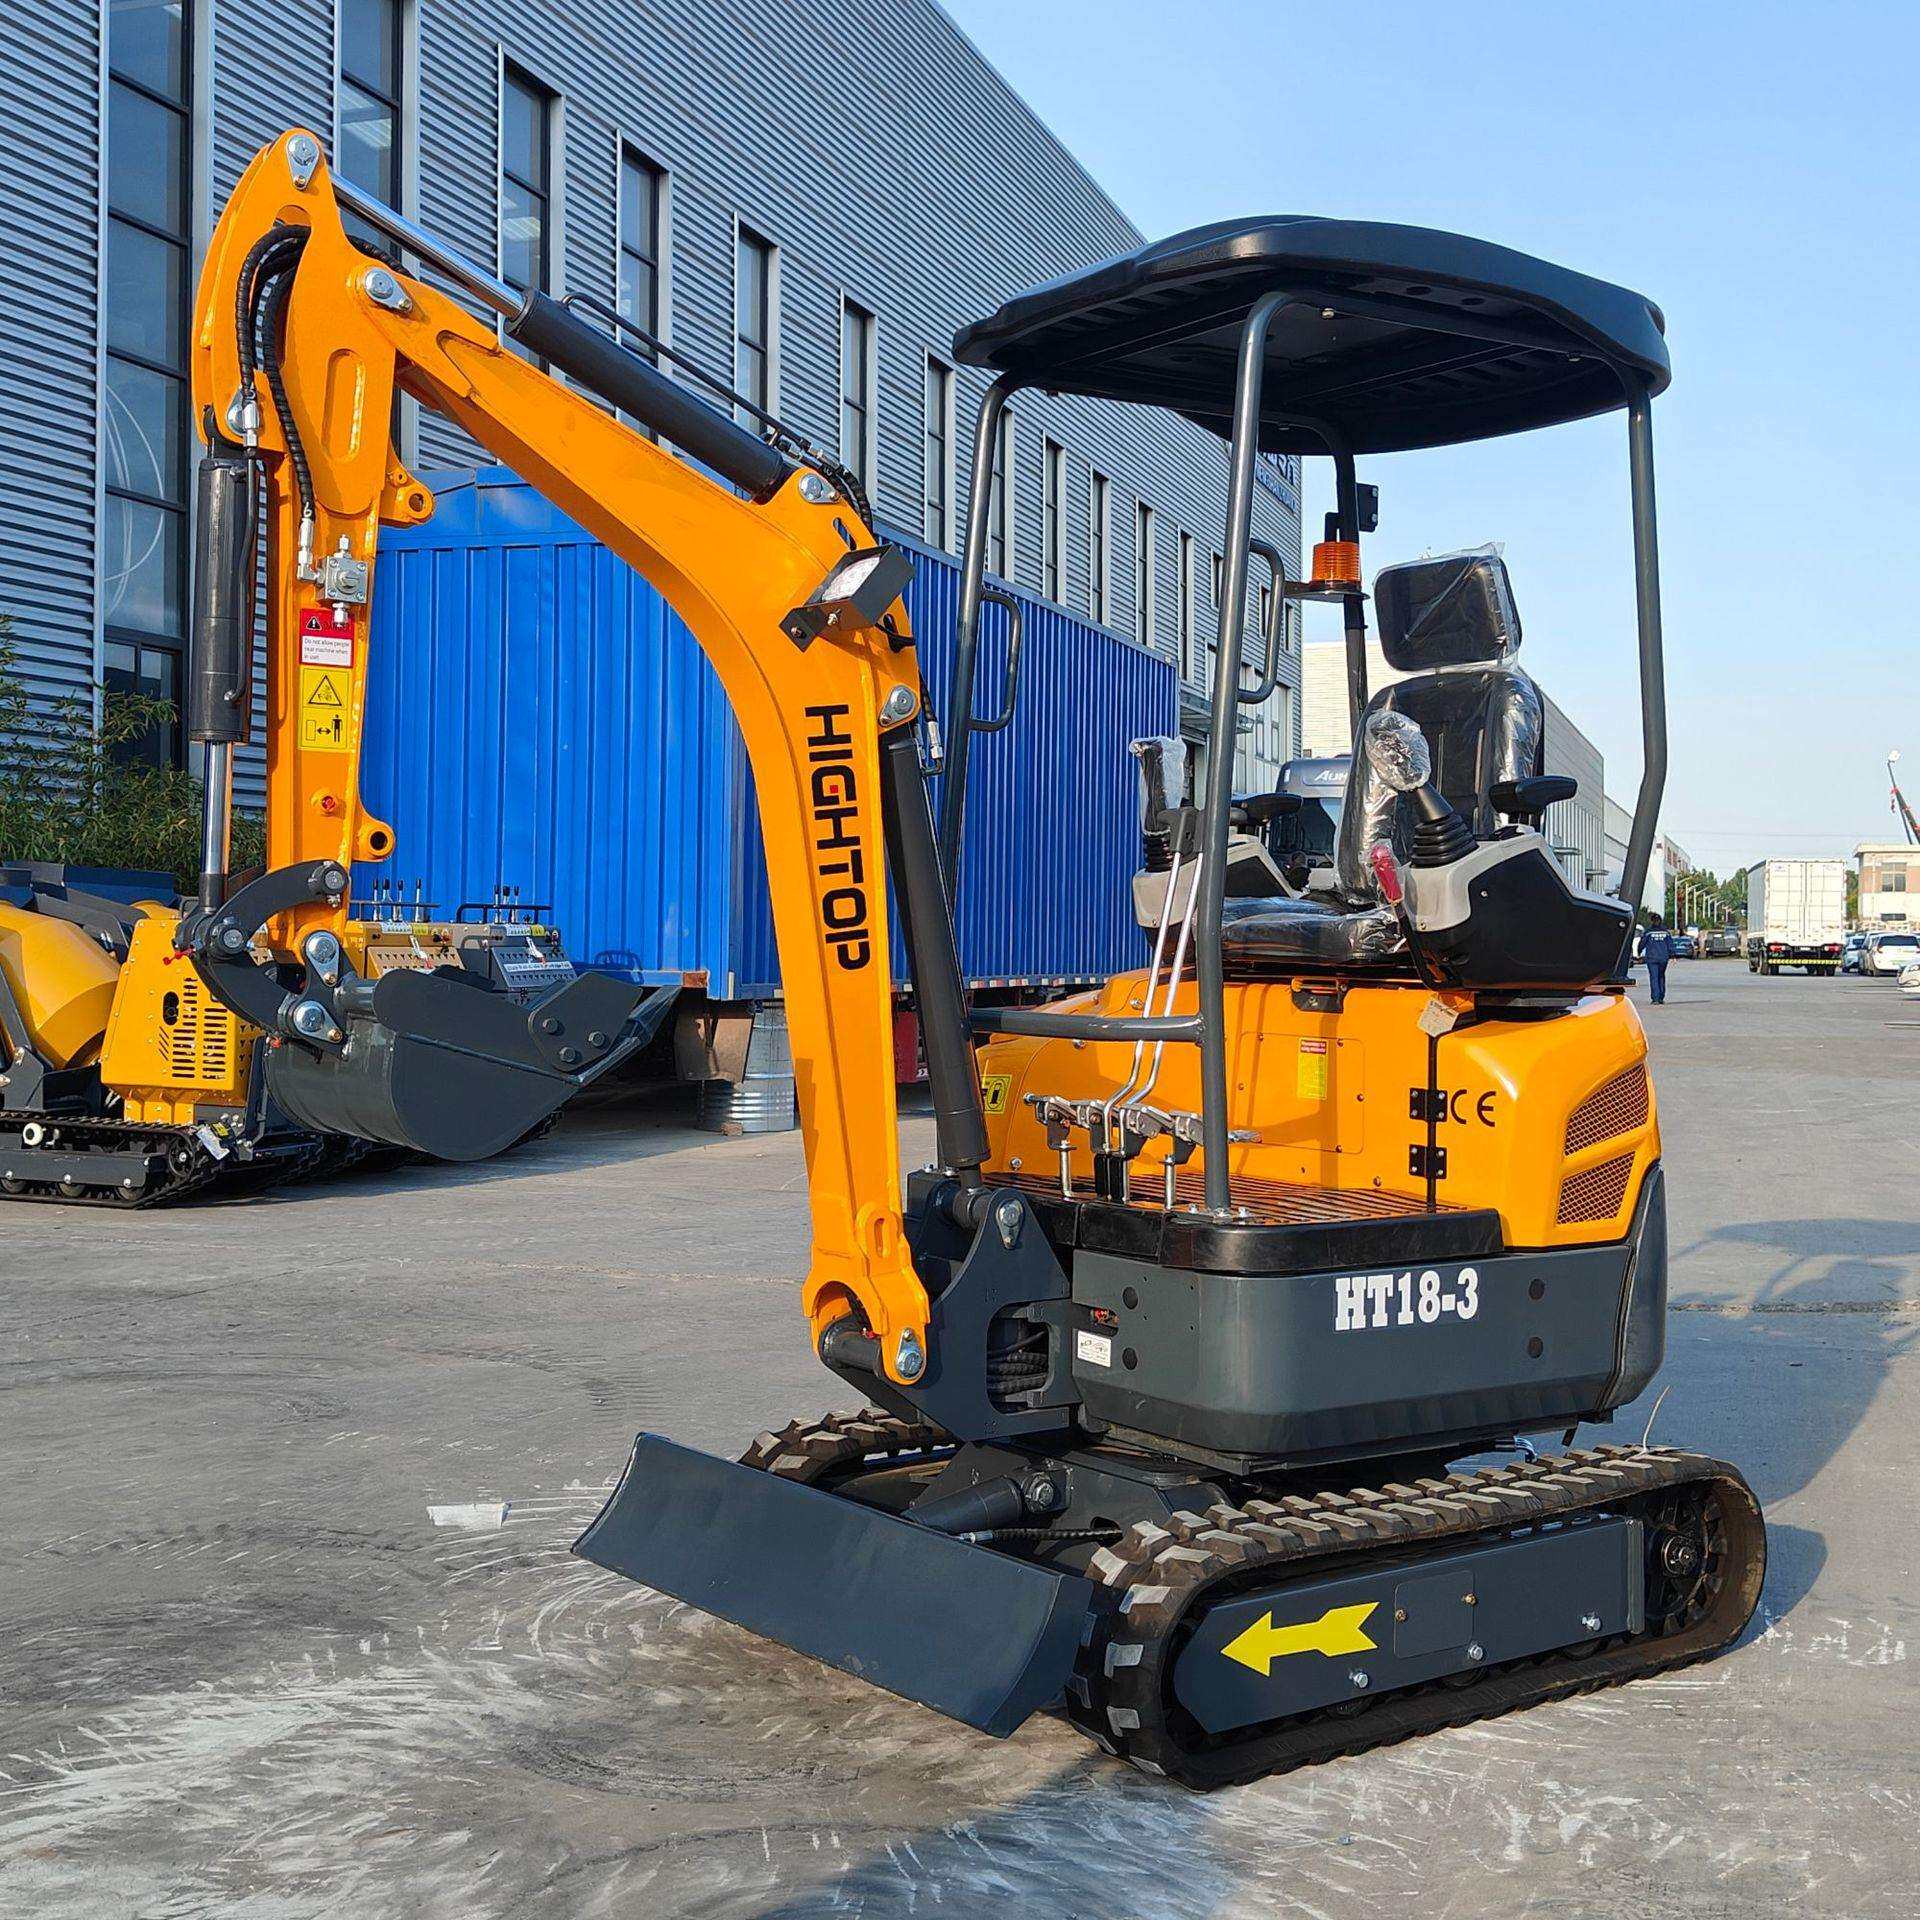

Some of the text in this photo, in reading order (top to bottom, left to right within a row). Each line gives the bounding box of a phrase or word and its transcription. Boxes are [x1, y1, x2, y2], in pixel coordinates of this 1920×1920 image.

[805, 704, 871, 972] HIGHTOP
[1450, 1088, 1497, 1127] CE
[1334, 1267, 1479, 1332] HT18-3
